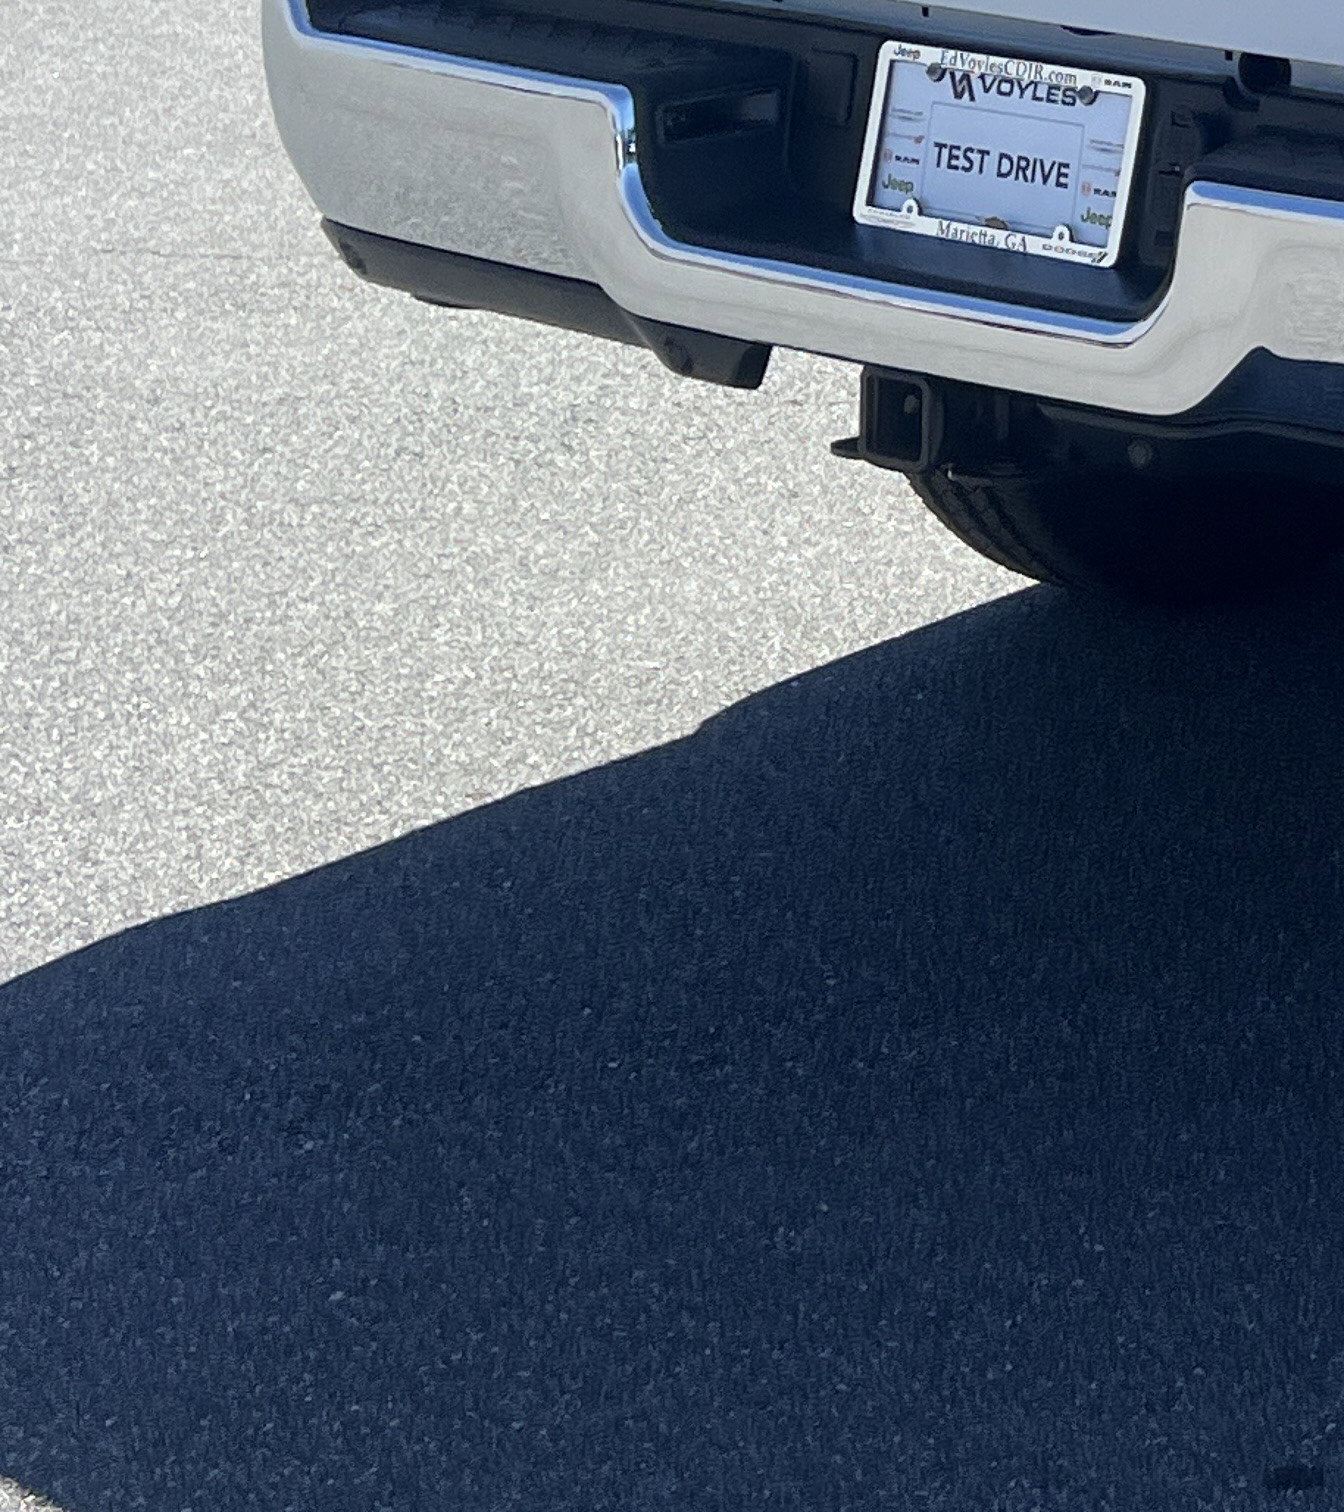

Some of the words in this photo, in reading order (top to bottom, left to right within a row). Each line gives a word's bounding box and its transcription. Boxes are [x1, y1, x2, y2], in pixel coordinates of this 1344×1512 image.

[894, 44, 921, 61] Jeep
[977, 74, 1078, 107] VOYLES
[933, 140, 991, 175] TEST
[996, 152, 1071, 190] DRIVE
[881, 173, 914, 195] Jeep
[1081, 206, 1113, 230] Jeep
[935, 219, 1001, 249] Marietta,
[1004, 233, 1029, 252] GA
